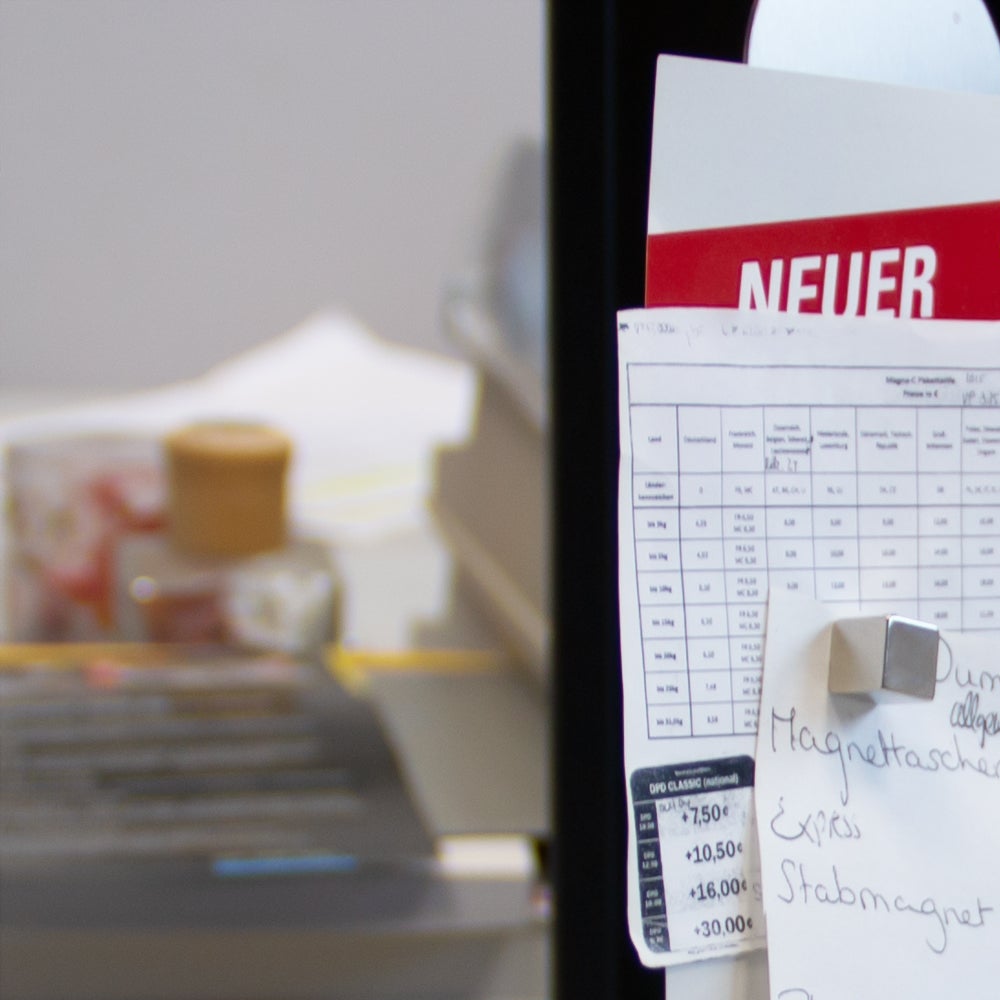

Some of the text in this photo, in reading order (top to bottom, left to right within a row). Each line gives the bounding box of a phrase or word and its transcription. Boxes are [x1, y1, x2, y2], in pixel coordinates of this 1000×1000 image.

[738, 245, 937, 318] NEUER
[667, 777, 702, 793] CLASSIC
[777, 858, 994, 955] Stabmagnet
